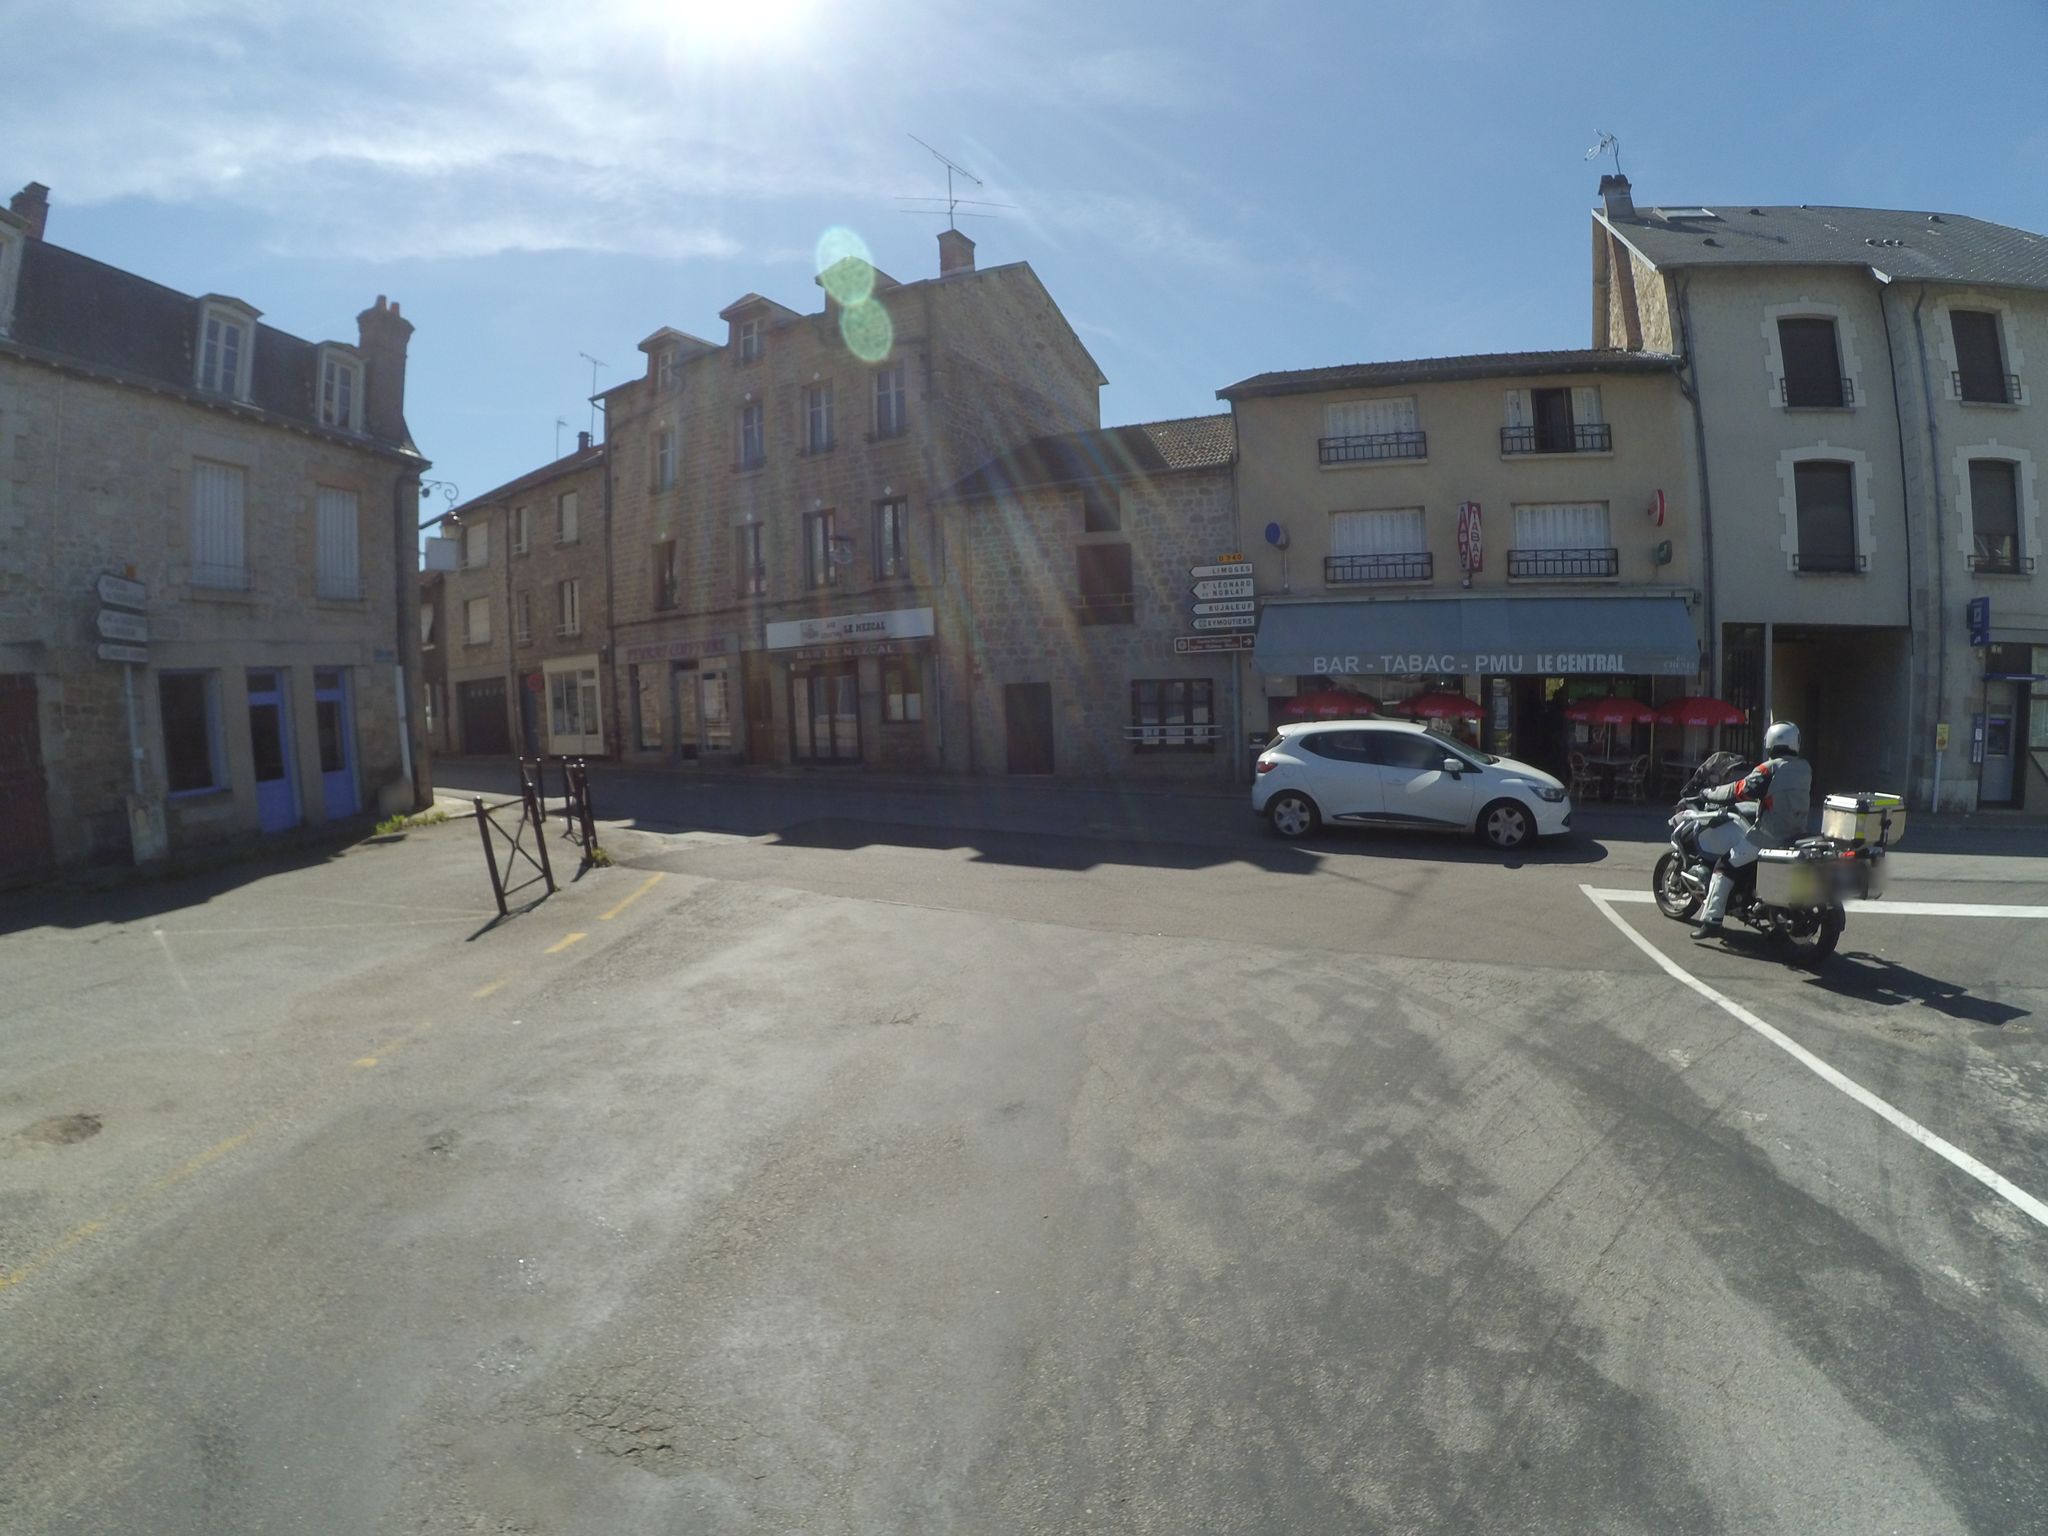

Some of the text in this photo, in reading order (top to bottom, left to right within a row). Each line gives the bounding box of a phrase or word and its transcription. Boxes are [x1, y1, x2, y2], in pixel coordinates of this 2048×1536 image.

[1470, 508, 1481, 565] TABAC
[1212, 565, 1251, 574] LIMOGES
[1213, 588, 1244, 597] NOBLAT
[1208, 603, 1252, 612] BUJALEUF
[855, 621, 886, 633] MEZCAL
[1207, 617, 1253, 627] EYMOUTIERS
[843, 644, 895, 657] MEZCAL
[1313, 656, 1360, 673] BAR
[1380, 655, 1456, 673] TABAC
[1475, 655, 1524, 673] PMU
[1536, 654, 1553, 673] LE
[1556, 654, 1625, 673] CENTRAL
